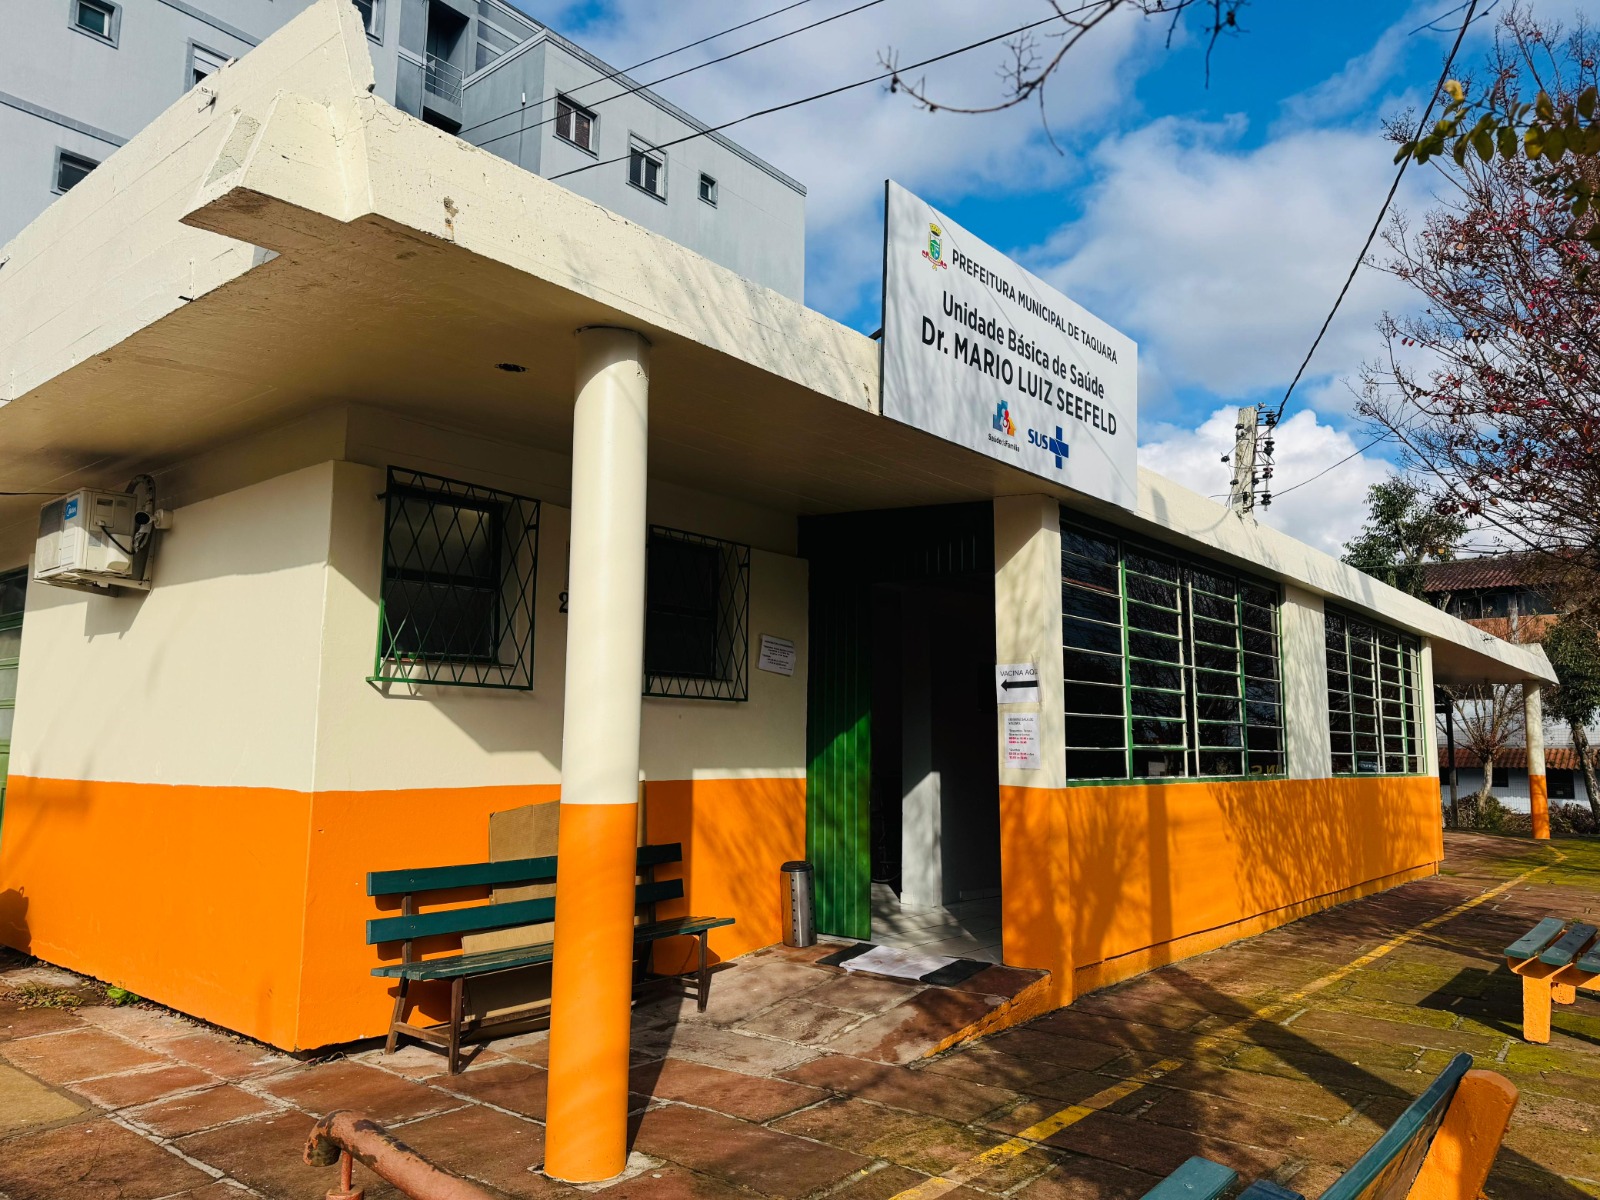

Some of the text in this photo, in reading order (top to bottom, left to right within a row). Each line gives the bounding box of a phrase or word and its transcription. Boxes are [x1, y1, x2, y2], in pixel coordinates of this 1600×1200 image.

[942, 290, 1105, 400] Unidade Básica de Saúde
[952, 248, 1118, 365] PREFEITURA MUNICIPAL DE TAQUARA
[921, 315, 1117, 436] Dr. MARIO LUIZ SEEFELD
[1027, 428, 1049, 450] SUS
[1000, 669, 1024, 677] VACINA
